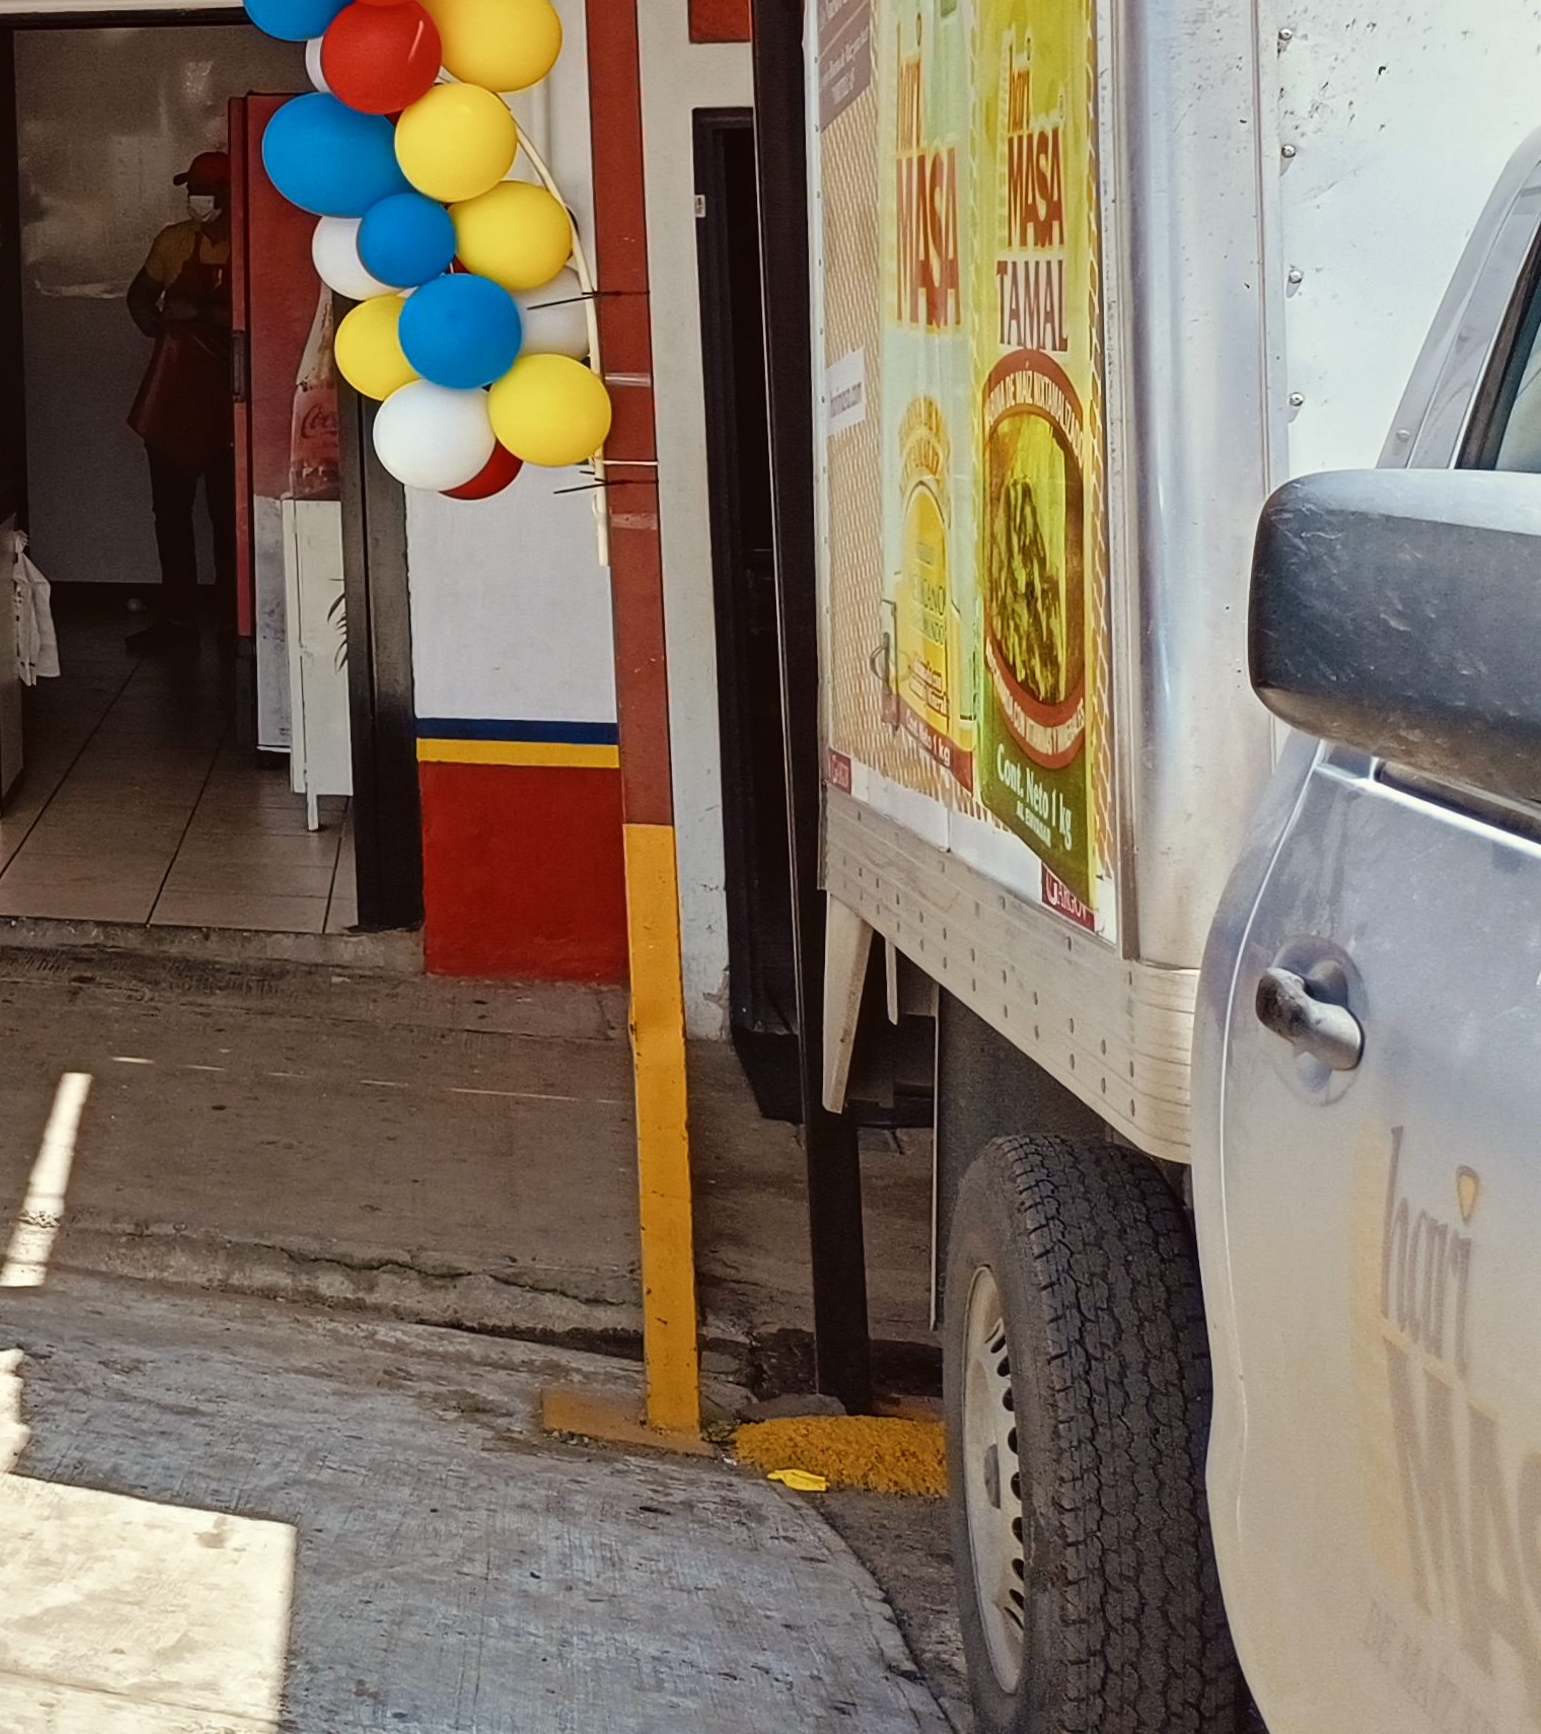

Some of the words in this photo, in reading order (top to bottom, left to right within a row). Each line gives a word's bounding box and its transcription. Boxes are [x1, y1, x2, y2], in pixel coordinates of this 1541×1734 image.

[895, 146, 961, 329] MASA
[1007, 126, 1066, 249] MASA
[995, 259, 1069, 353] TAMAL
[997, 743, 1024, 799] Cont.
[1026, 767, 1049, 820] Neto
[1059, 792, 1072, 851] kg
